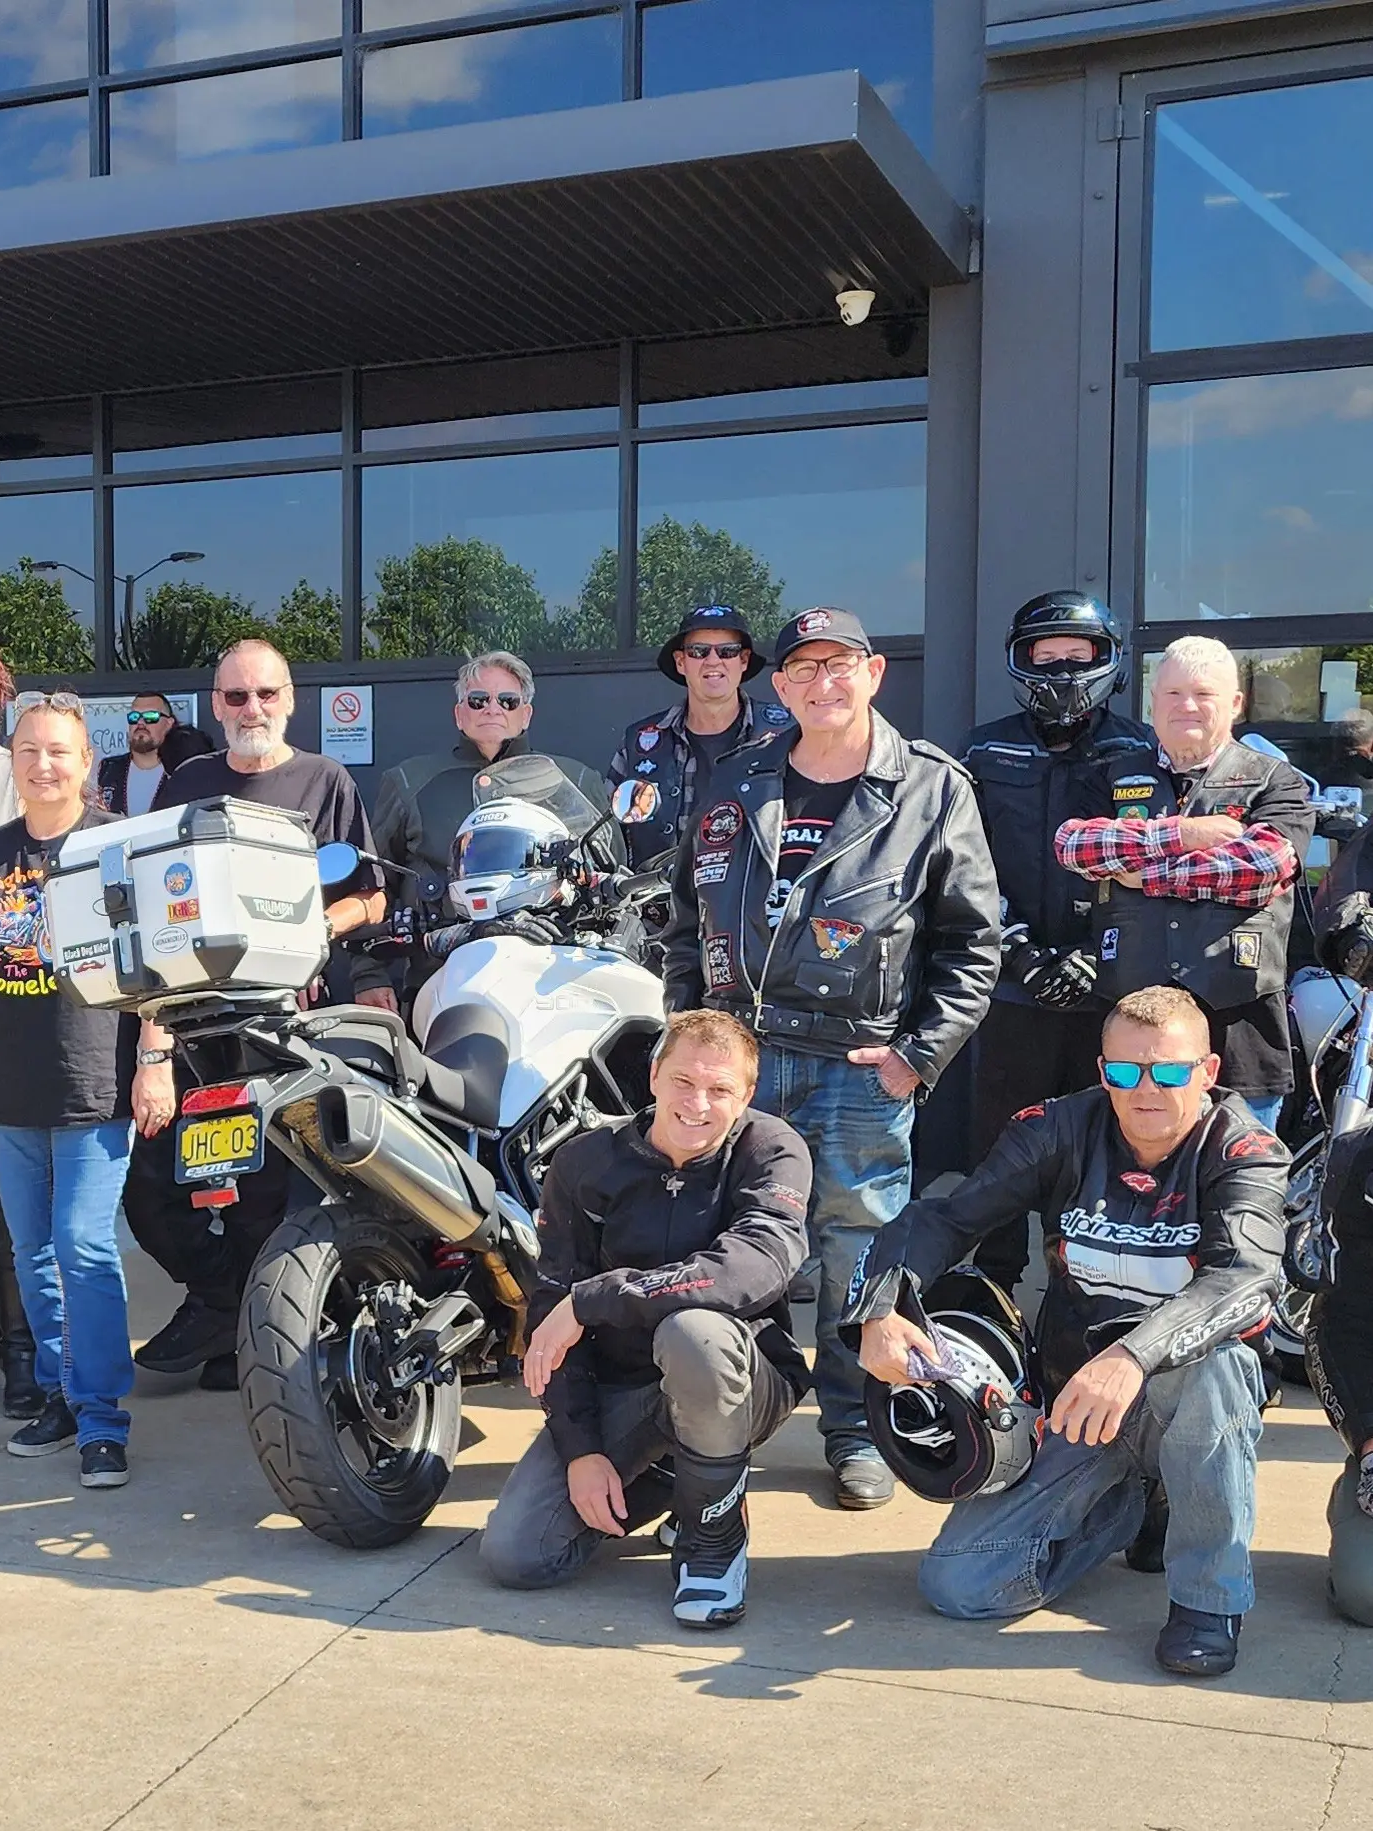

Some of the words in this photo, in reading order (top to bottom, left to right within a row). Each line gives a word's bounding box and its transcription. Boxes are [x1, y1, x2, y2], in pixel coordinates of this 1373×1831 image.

[92, 728, 129, 755] CAR
[474, 811, 507, 823] SHOEI
[253, 898, 295, 920] TRIUMPH
[4, 964, 28, 977] The
[207, 1117, 232, 1127] NSW
[182, 1129, 222, 1161] JHC
[231, 1124, 258, 1154] 03
[1060, 1207, 1201, 1247] alpinestars
[618, 1263, 699, 1299] RST
[701, 1466, 748, 1524] RST
